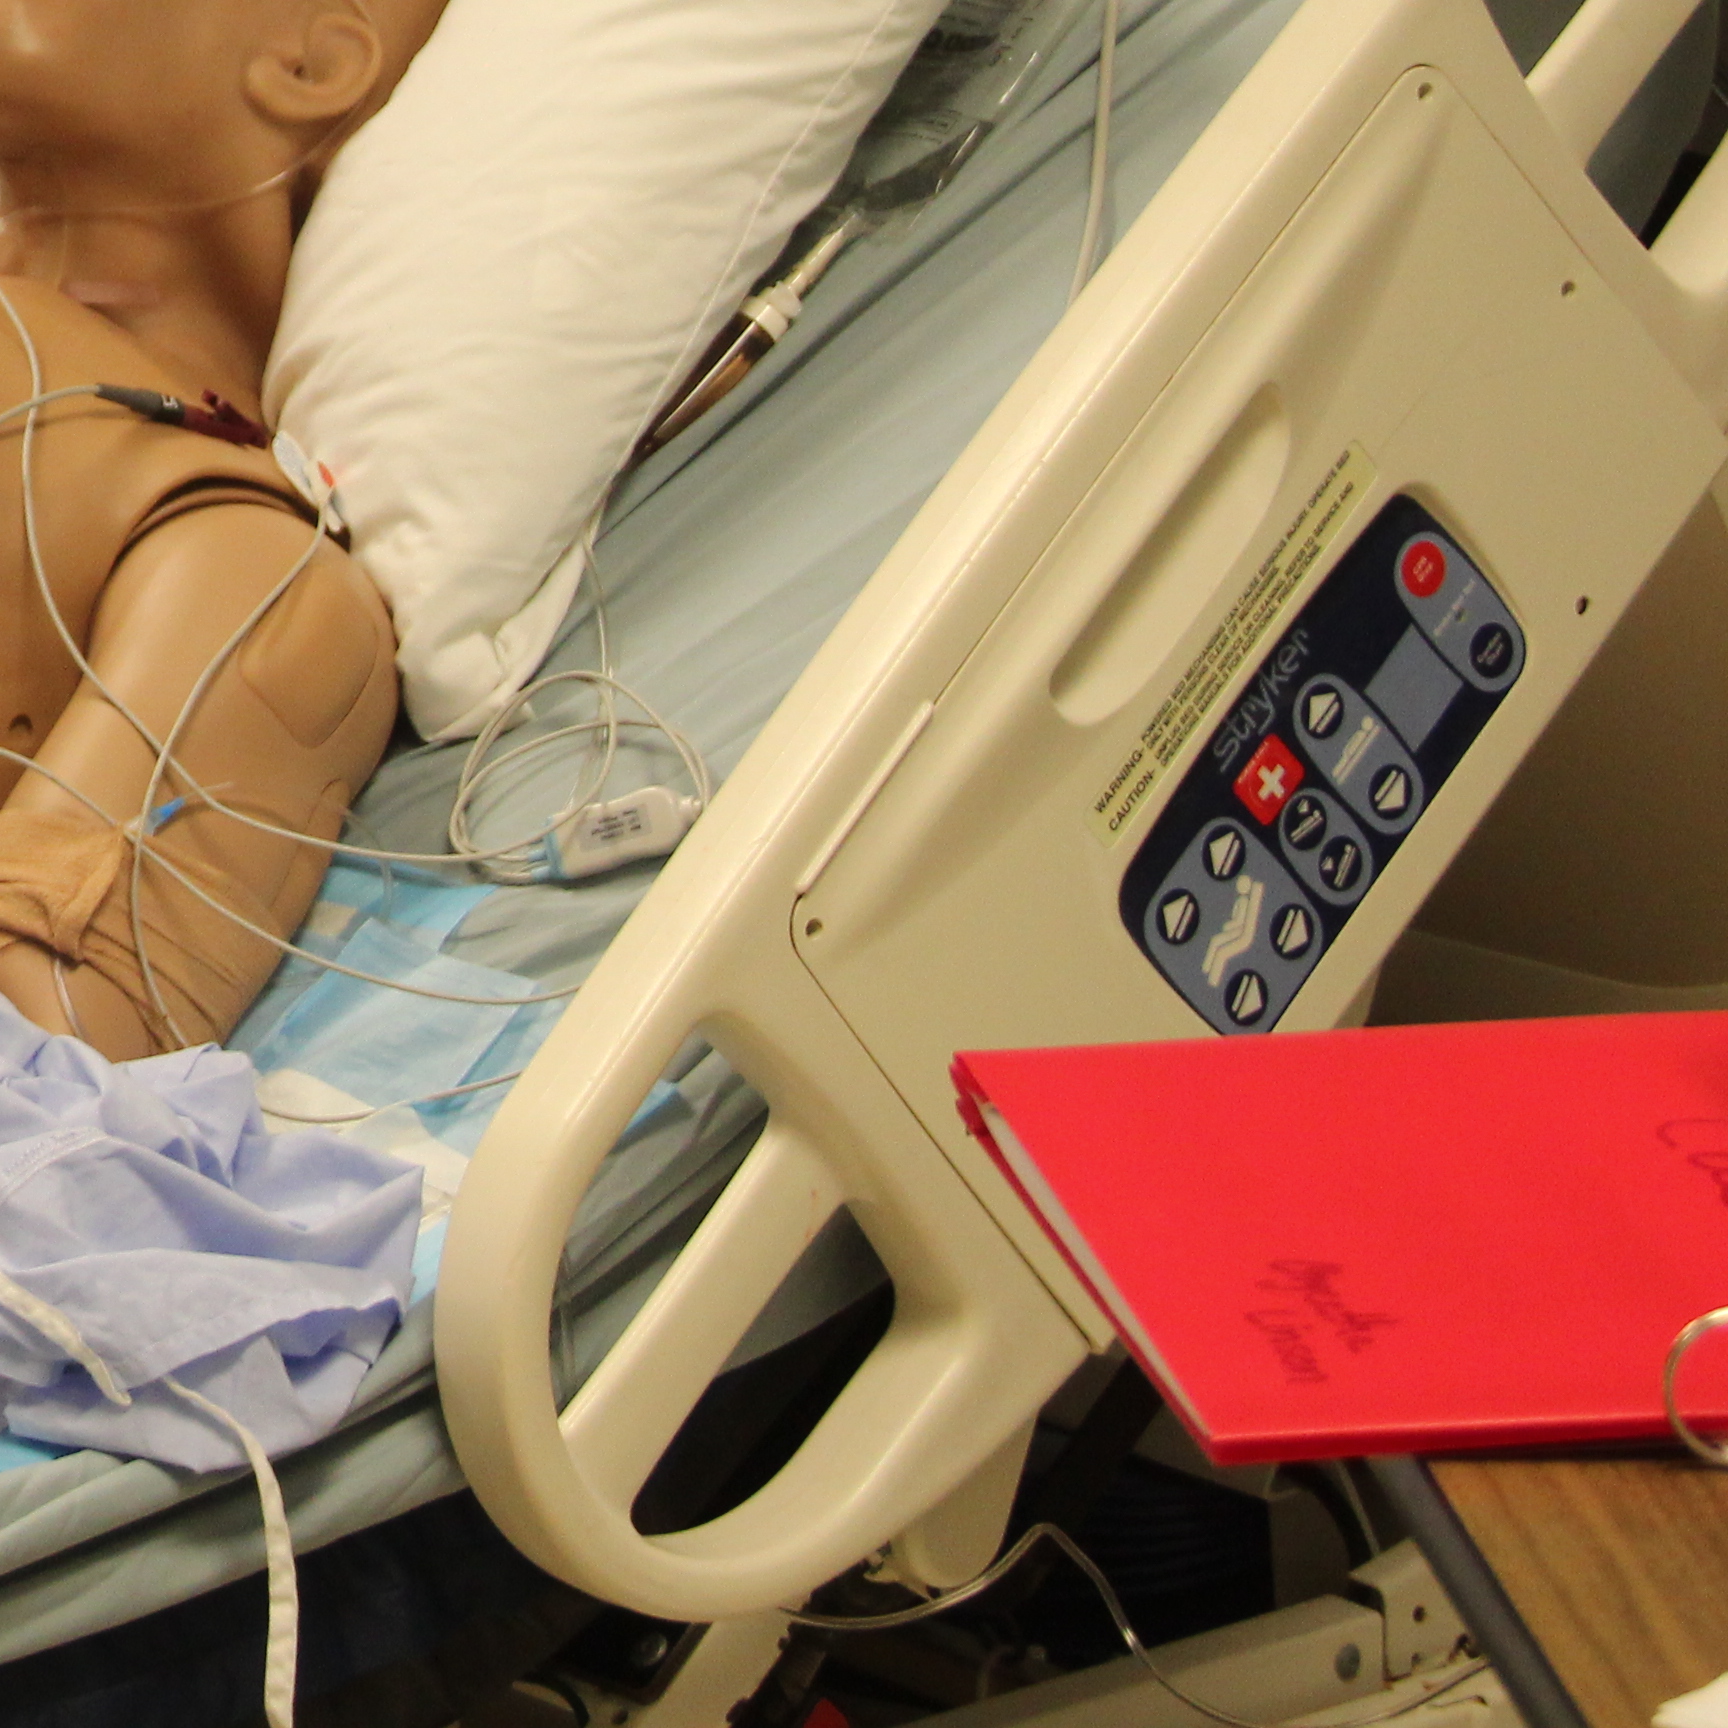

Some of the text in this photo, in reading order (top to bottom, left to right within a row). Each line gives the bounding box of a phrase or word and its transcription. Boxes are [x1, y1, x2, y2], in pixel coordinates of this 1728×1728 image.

[1211, 627, 1315, 772] stryker
[1095, 743, 1144, 814] WARNING-
[1108, 764, 1155, 832] CAUTION-
